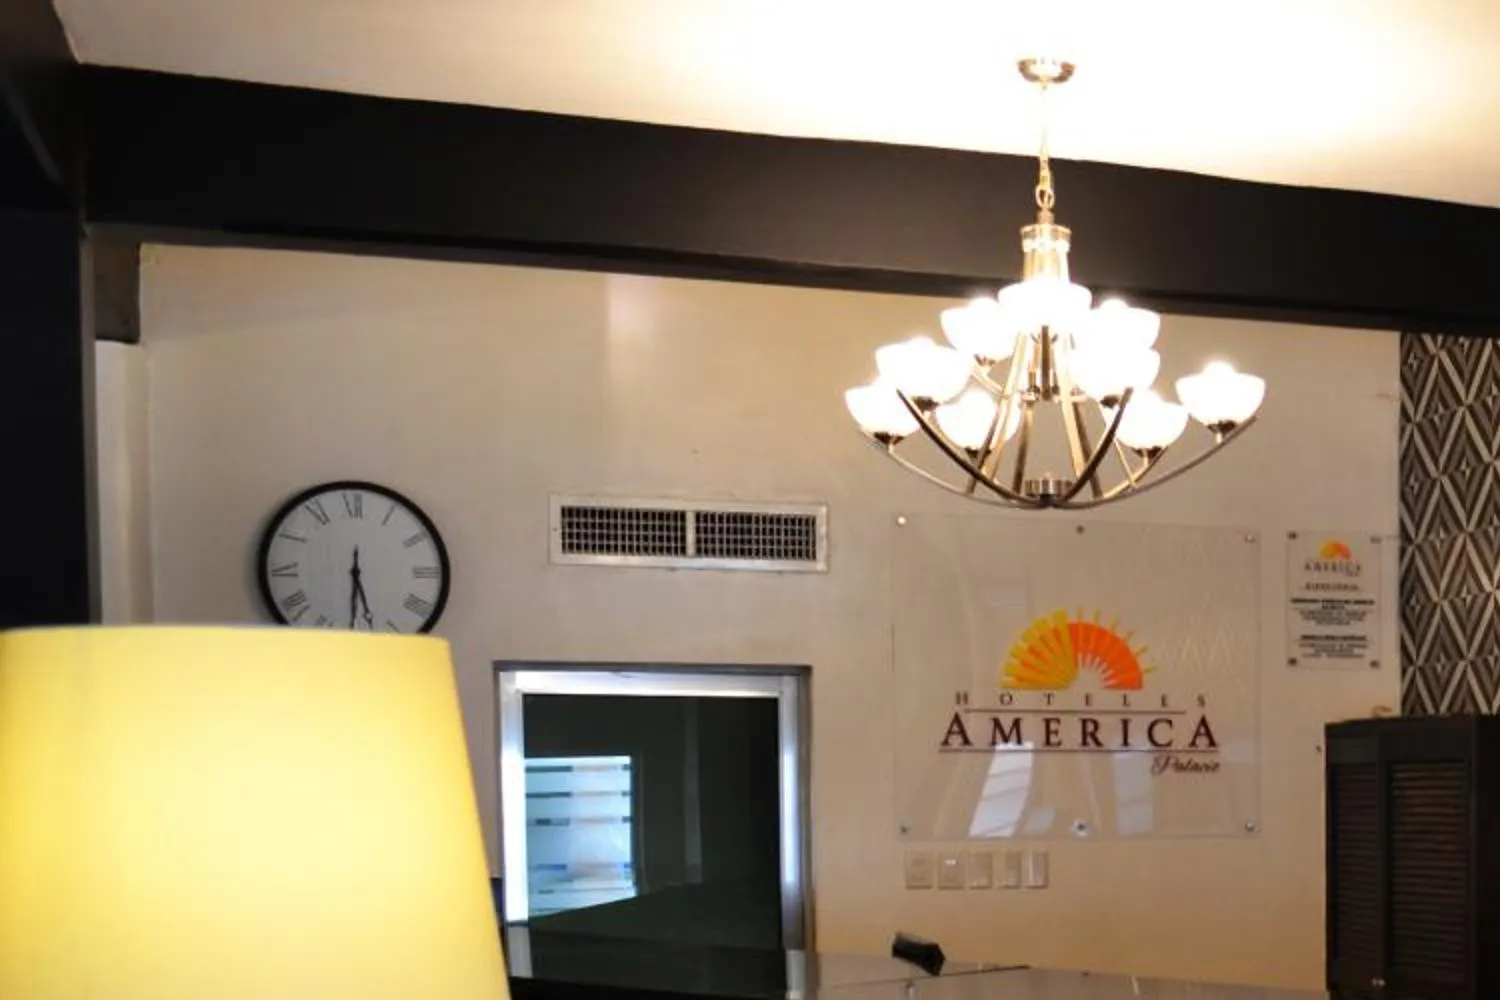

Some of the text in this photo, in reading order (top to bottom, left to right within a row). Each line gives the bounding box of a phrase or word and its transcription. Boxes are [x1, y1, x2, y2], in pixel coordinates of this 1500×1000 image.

[955, 692, 1207, 707] HOTELES
[941, 712, 1218, 748] AMERICA
[1151, 754, 1220, 776] Palacio
